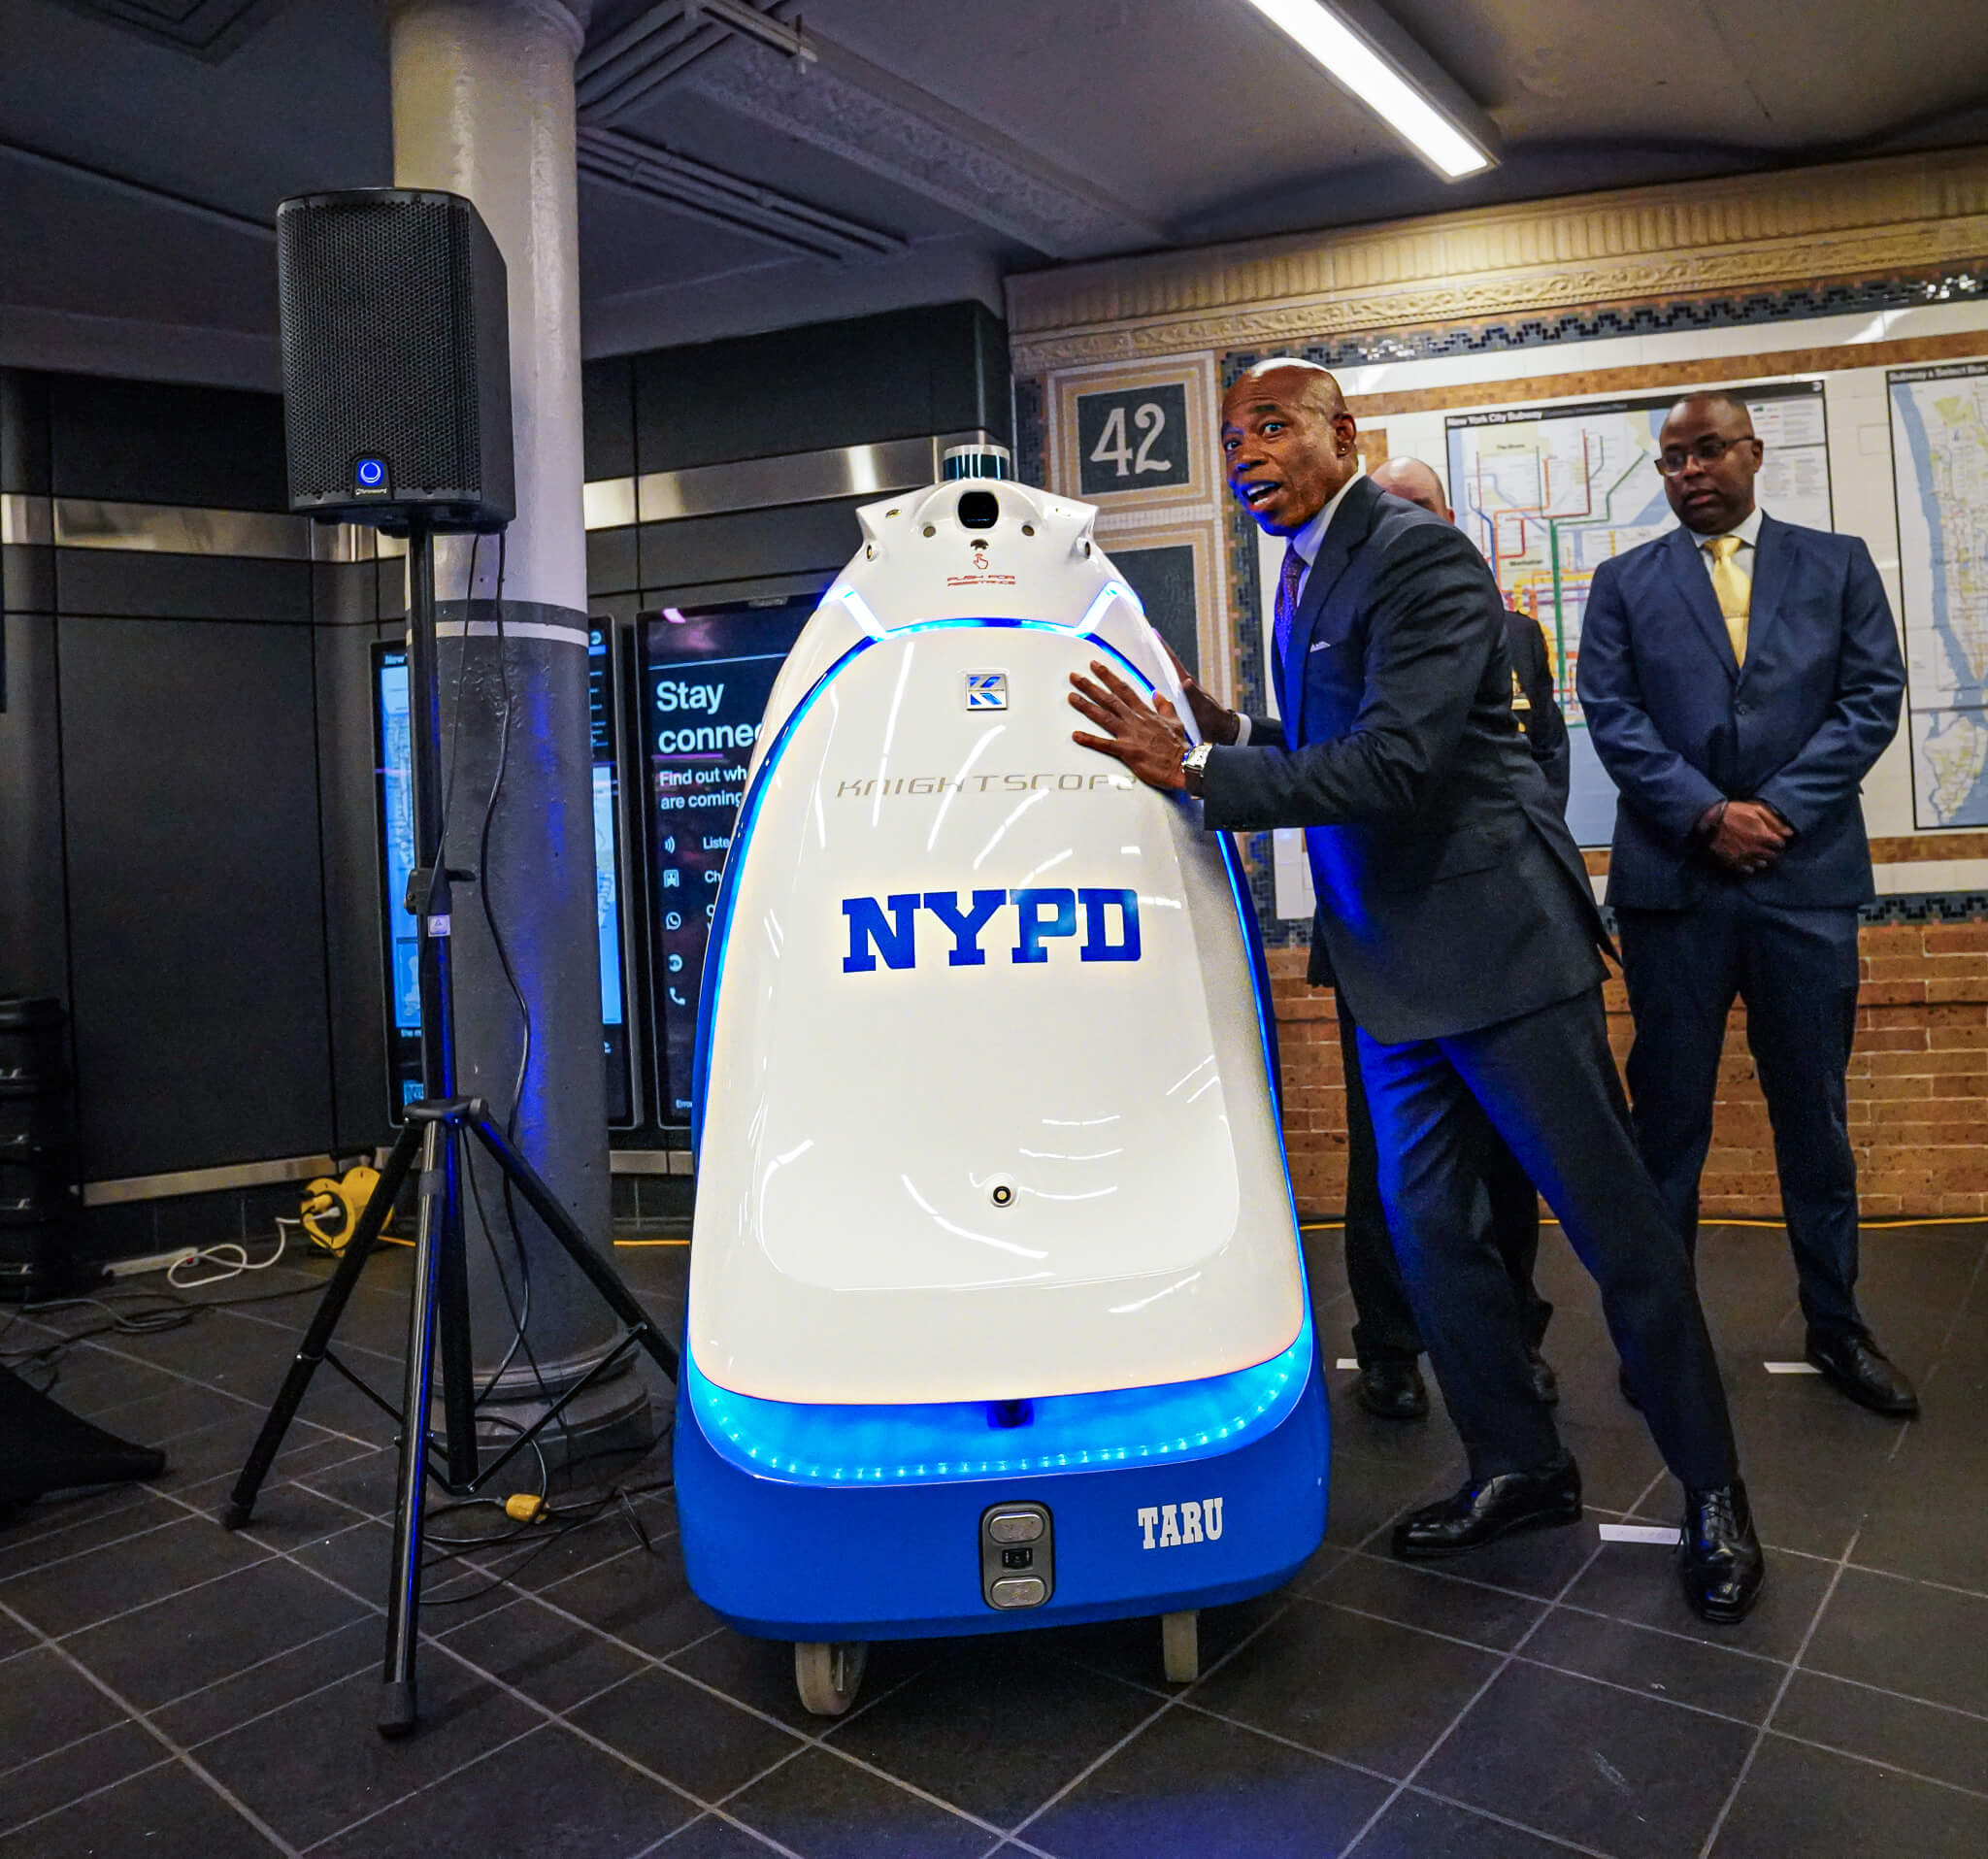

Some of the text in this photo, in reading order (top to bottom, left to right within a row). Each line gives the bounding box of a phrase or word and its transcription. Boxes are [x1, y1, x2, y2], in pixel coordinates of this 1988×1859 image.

[1089, 402, 1173, 477] 42
[656, 681, 725, 715] Stay
[660, 769, 692, 787] Find
[695, 767, 721, 784] out
[660, 796, 685, 811] are
[842, 887, 1142, 974] NYPD
[1138, 1497, 1223, 1550] TARU
